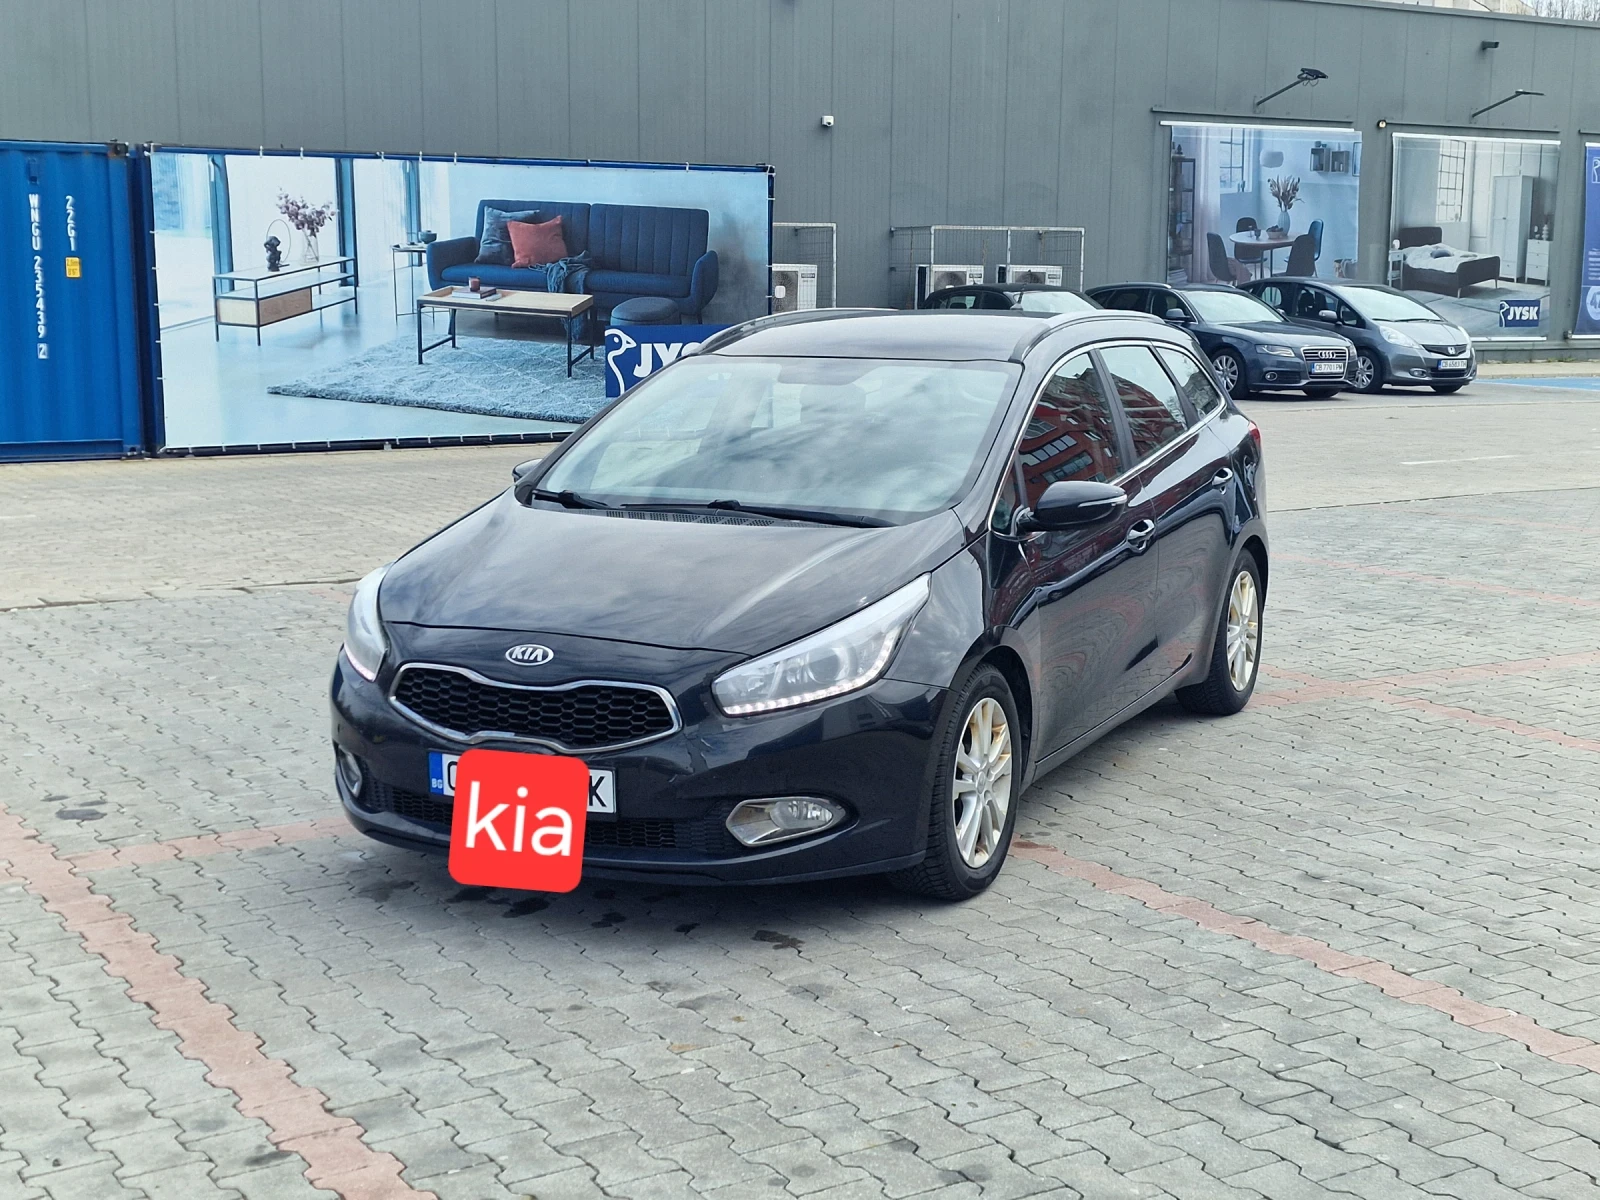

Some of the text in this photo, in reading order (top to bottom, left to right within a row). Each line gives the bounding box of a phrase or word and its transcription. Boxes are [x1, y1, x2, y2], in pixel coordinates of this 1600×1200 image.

[66, 195, 76, 251] 22G1
[29, 193, 48, 359] WNGU 235439 2
[1507, 306, 1539, 320] JYSK
[511, 646, 544, 661] KIA
[431, 778, 443, 789] BG
